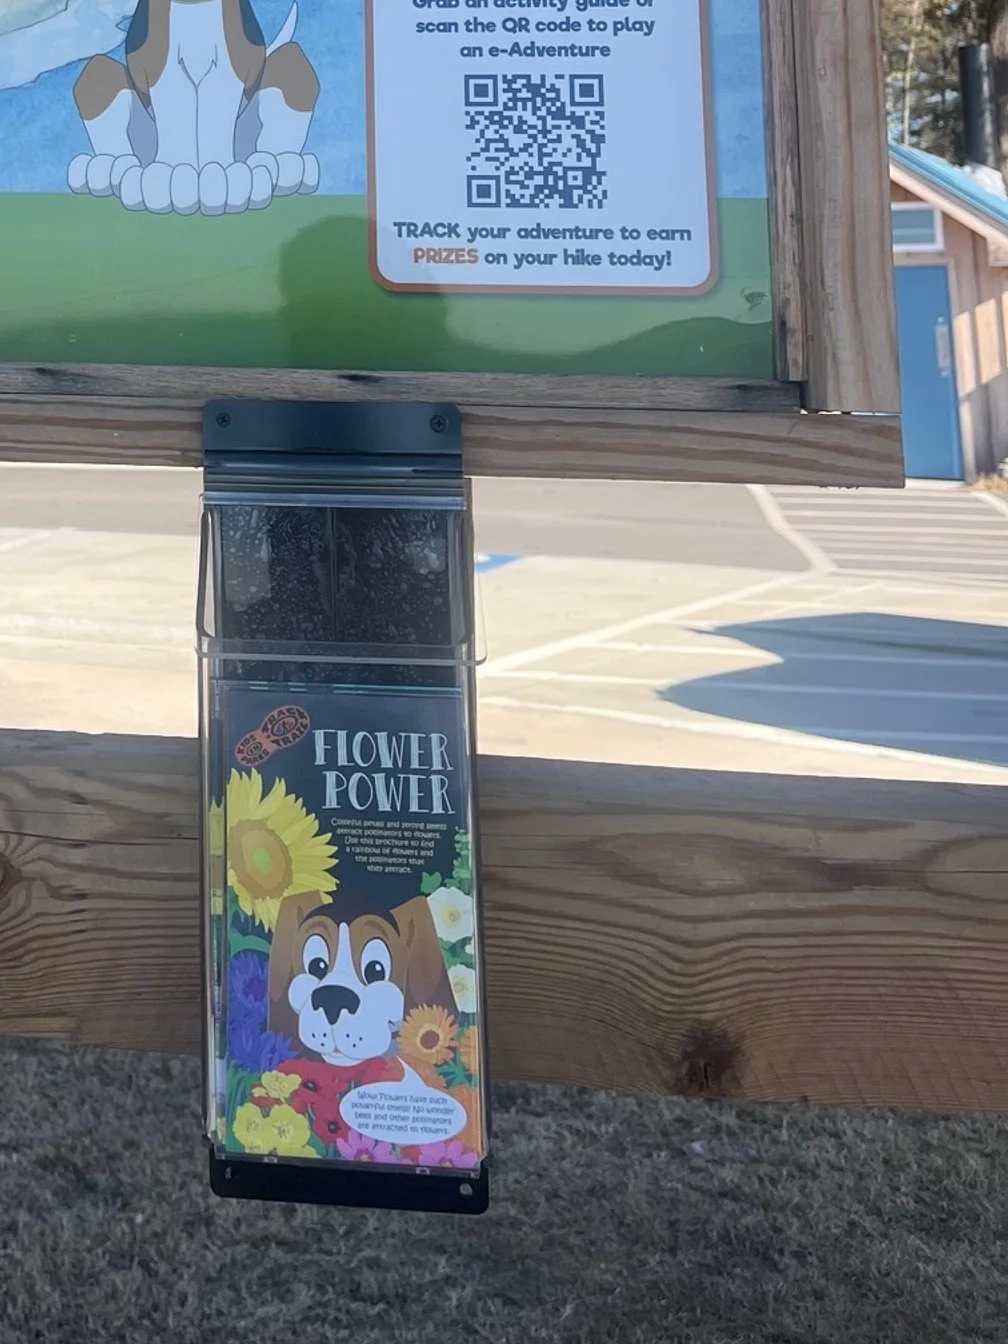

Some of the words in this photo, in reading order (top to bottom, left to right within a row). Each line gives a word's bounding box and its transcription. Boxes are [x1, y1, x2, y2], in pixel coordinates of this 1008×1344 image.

[415, 21, 458, 33] scan
[463, 18, 496, 32] the
[501, 18, 530, 33] QR
[534, 18, 581, 32] code
[586, 18, 607, 32] to
[612, 18, 655, 36] play
[459, 46, 483, 57] an
[488, 41, 611, 57] e-Adventure
[392, 221, 461, 238] TRACK
[466, 226, 511, 243] your
[516, 223, 614, 239] adventure
[619, 226, 641, 240] to
[646, 228, 691, 240] earn
[413, 247, 478, 263] PRIZES
[484, 252, 507, 264] on
[513, 252, 558, 269] your
[562, 248, 602, 265] hike
[607, 249, 671, 270] today!
[313, 729, 454, 770] FLOWER
[322, 771, 455, 814] POWER
